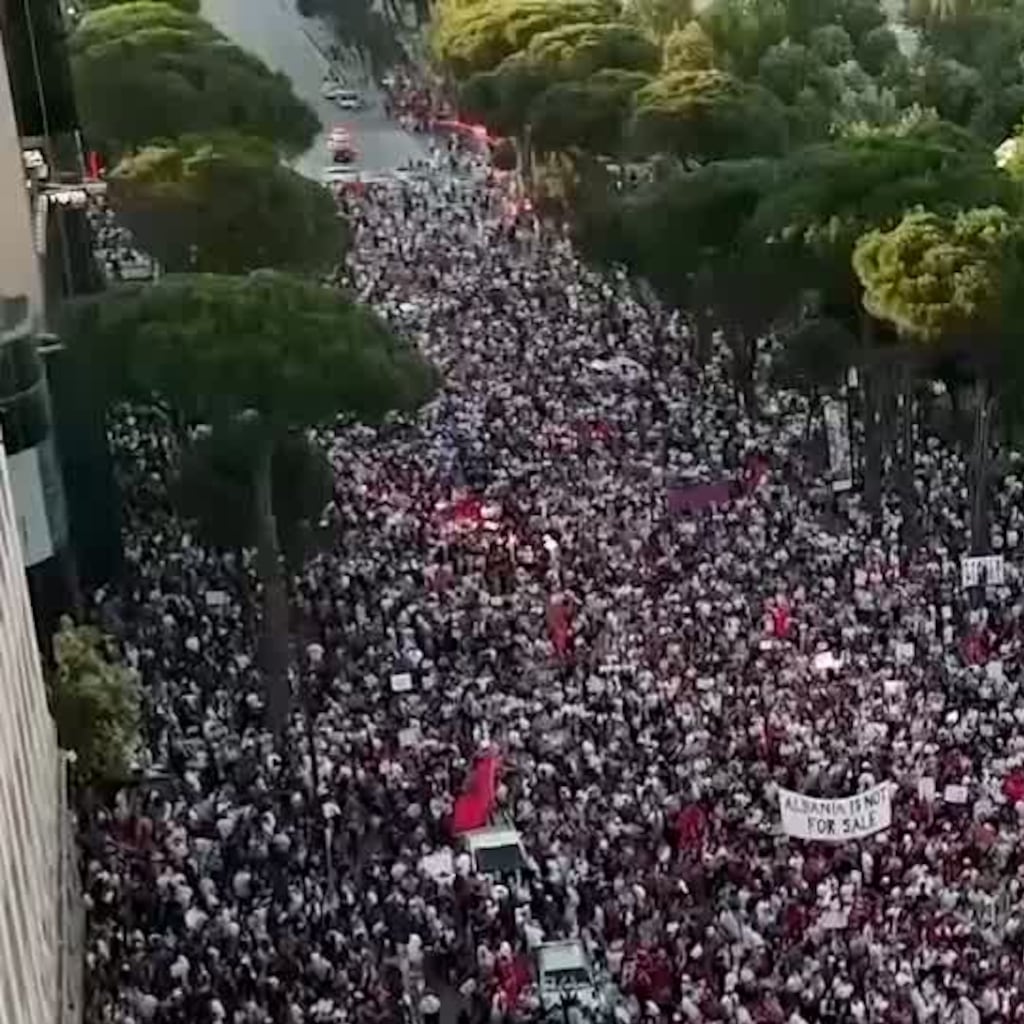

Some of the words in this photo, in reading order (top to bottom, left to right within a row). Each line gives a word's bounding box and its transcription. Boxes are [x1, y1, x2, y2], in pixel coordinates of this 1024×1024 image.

[784, 797, 846, 815] ALBANIA
[850, 797, 861, 815] IS
[807, 817, 835, 835] FOR
[843, 811, 877, 833] SALE
